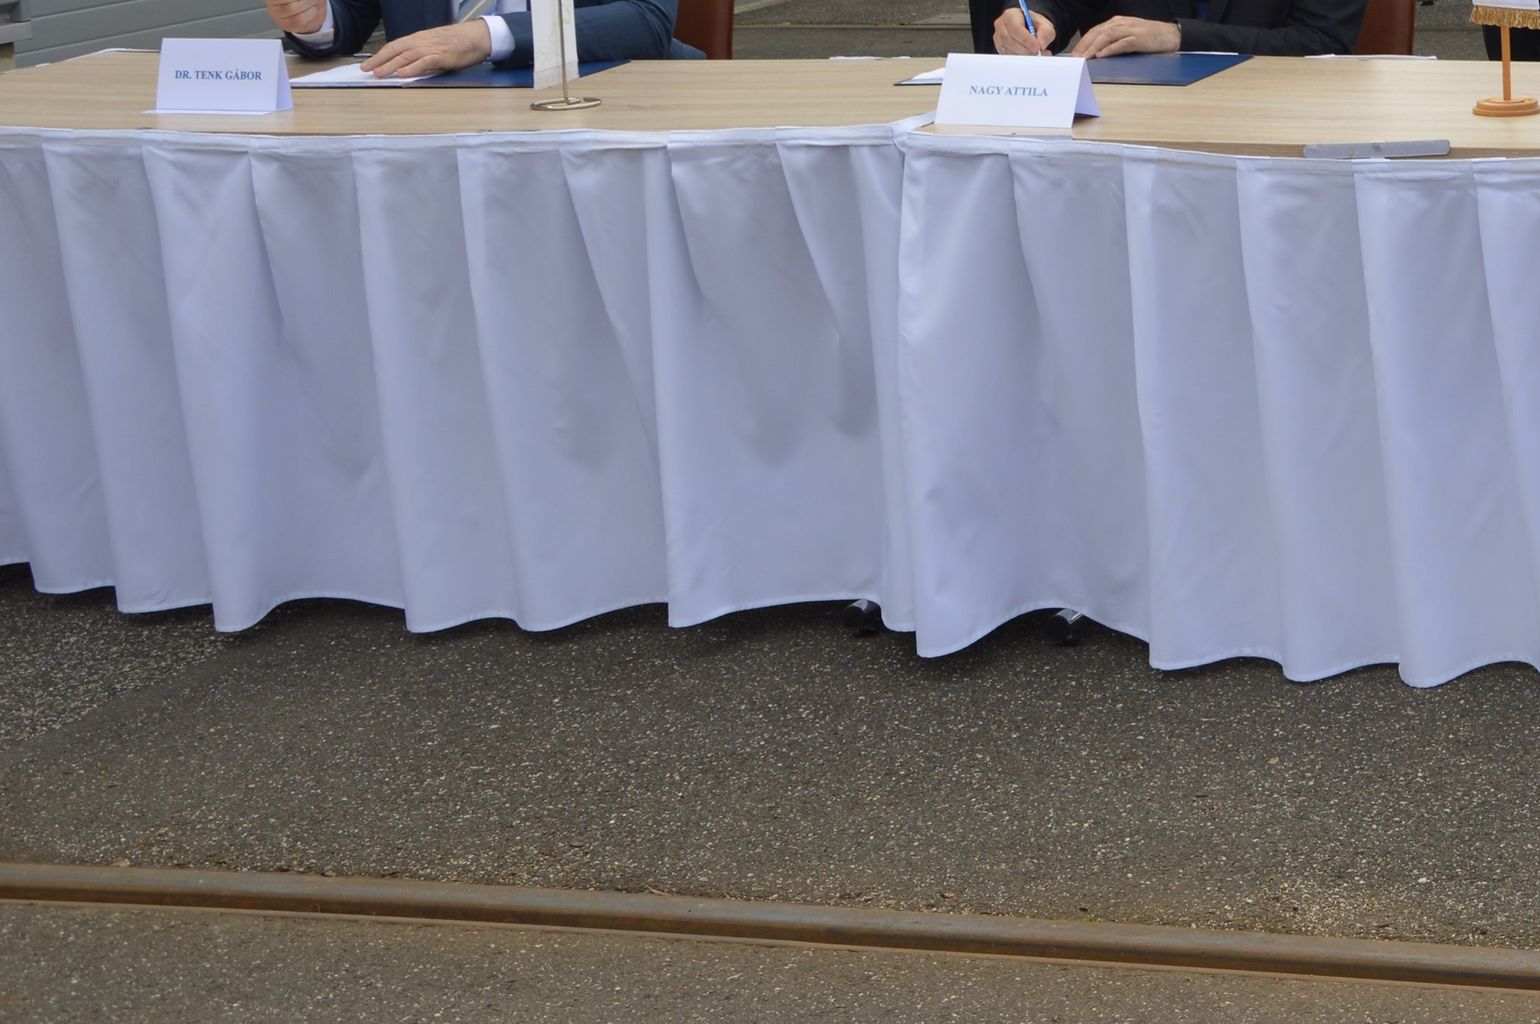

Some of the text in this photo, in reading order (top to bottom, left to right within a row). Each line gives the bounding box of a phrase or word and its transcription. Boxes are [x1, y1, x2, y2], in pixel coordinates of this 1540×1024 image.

[174, 68, 263, 81] DR. TENK GÁBOR
[969, 85, 1048, 97] NAGY ATTILA
